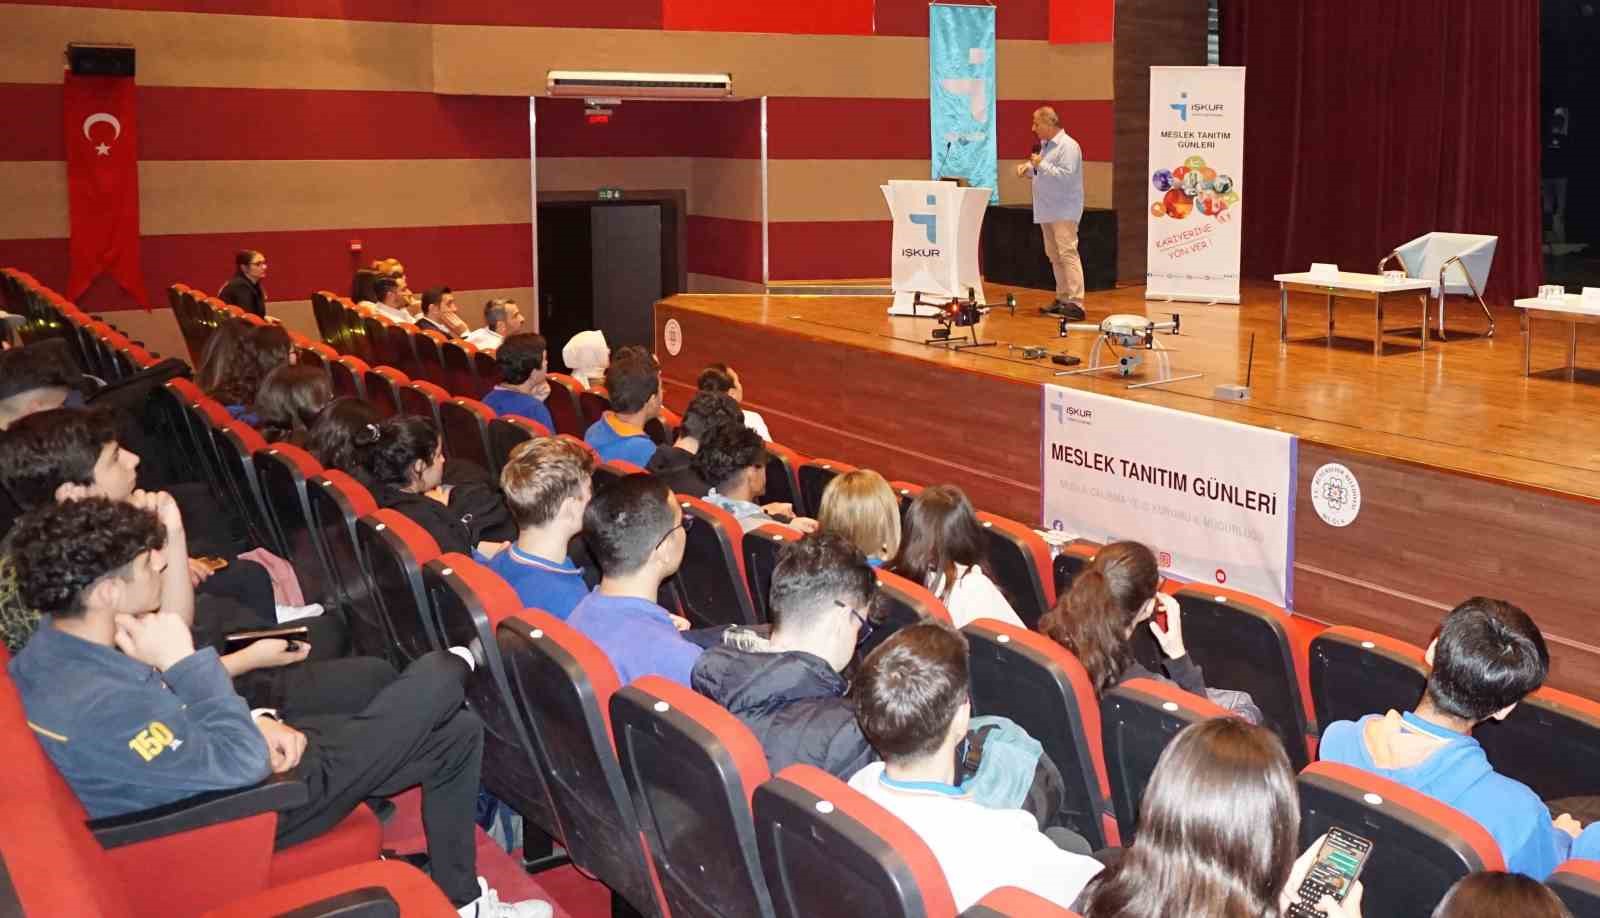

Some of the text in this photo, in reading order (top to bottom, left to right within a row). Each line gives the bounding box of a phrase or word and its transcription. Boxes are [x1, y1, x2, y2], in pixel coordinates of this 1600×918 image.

[1160, 131, 1231, 140] MESLEK TANITIM
[1051, 442, 1116, 475] MESLEK
[1120, 459, 1187, 493] TANITIM
[1193, 476, 1277, 516] GÜNLERİ
[128, 721, 175, 762] 150
